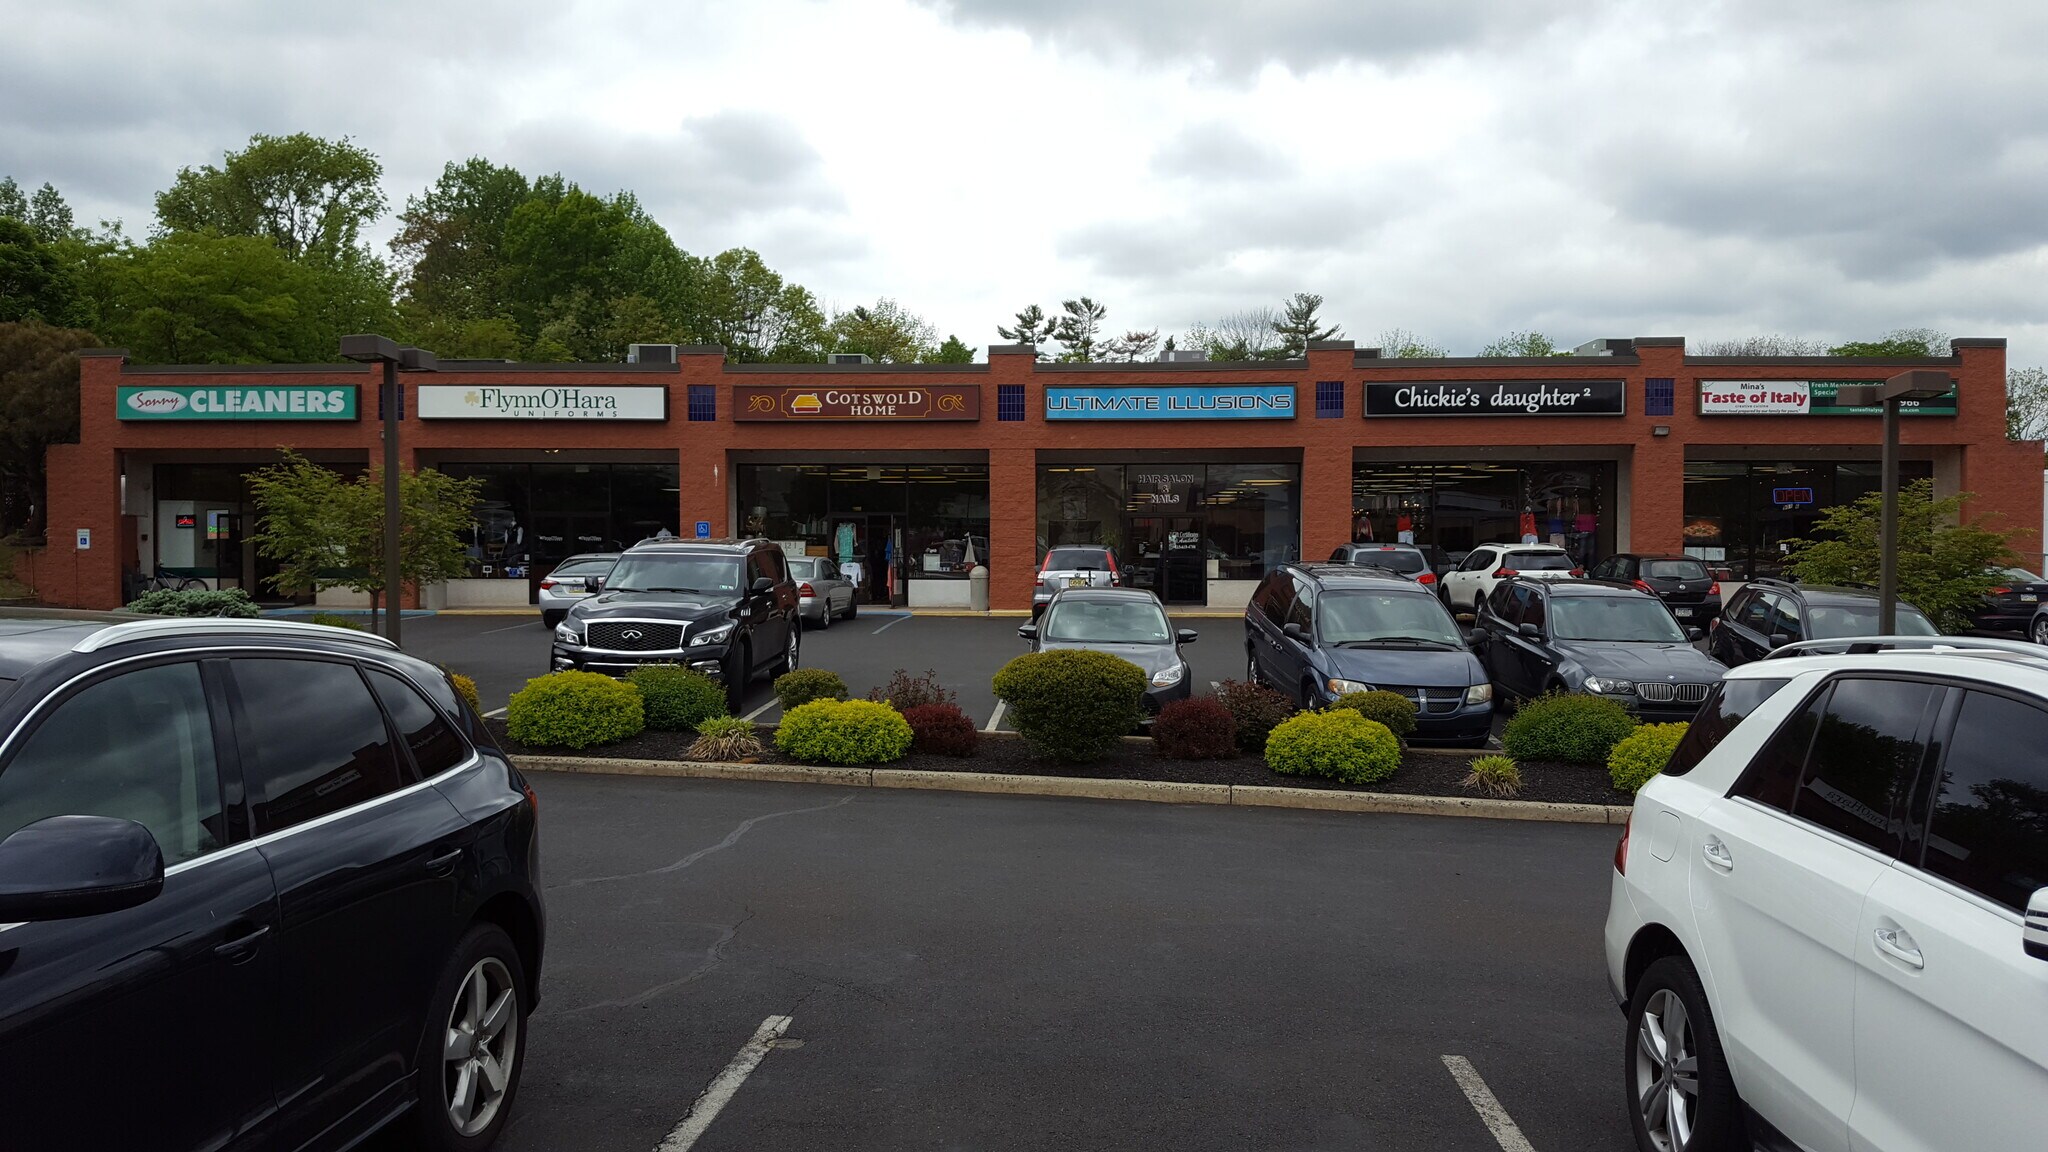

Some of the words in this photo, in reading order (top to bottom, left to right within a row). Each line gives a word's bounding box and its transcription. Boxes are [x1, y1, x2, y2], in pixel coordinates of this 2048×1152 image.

[137, 392, 180, 409] Sonny
[189, 390, 346, 413] CLEANERS
[480, 388, 617, 413] FlynnO'Hara
[1047, 395, 1160, 411] ULTIMATE
[1167, 393, 1292, 410] ILLUSIONS
[1394, 385, 1480, 408] Chickie's
[1702, 391, 1746, 404] Taste
[1749, 391, 1768, 404] of
[1770, 391, 1808, 407] Italy
[850, 405, 897, 416] HOME
[1138, 474, 1161, 484] HAIR
[1162, 474, 1195, 484] SALON
[1161, 484, 1170, 494] &
[1775, 490, 1811, 502] OPEN
[1151, 494, 1180, 504] NAILS
